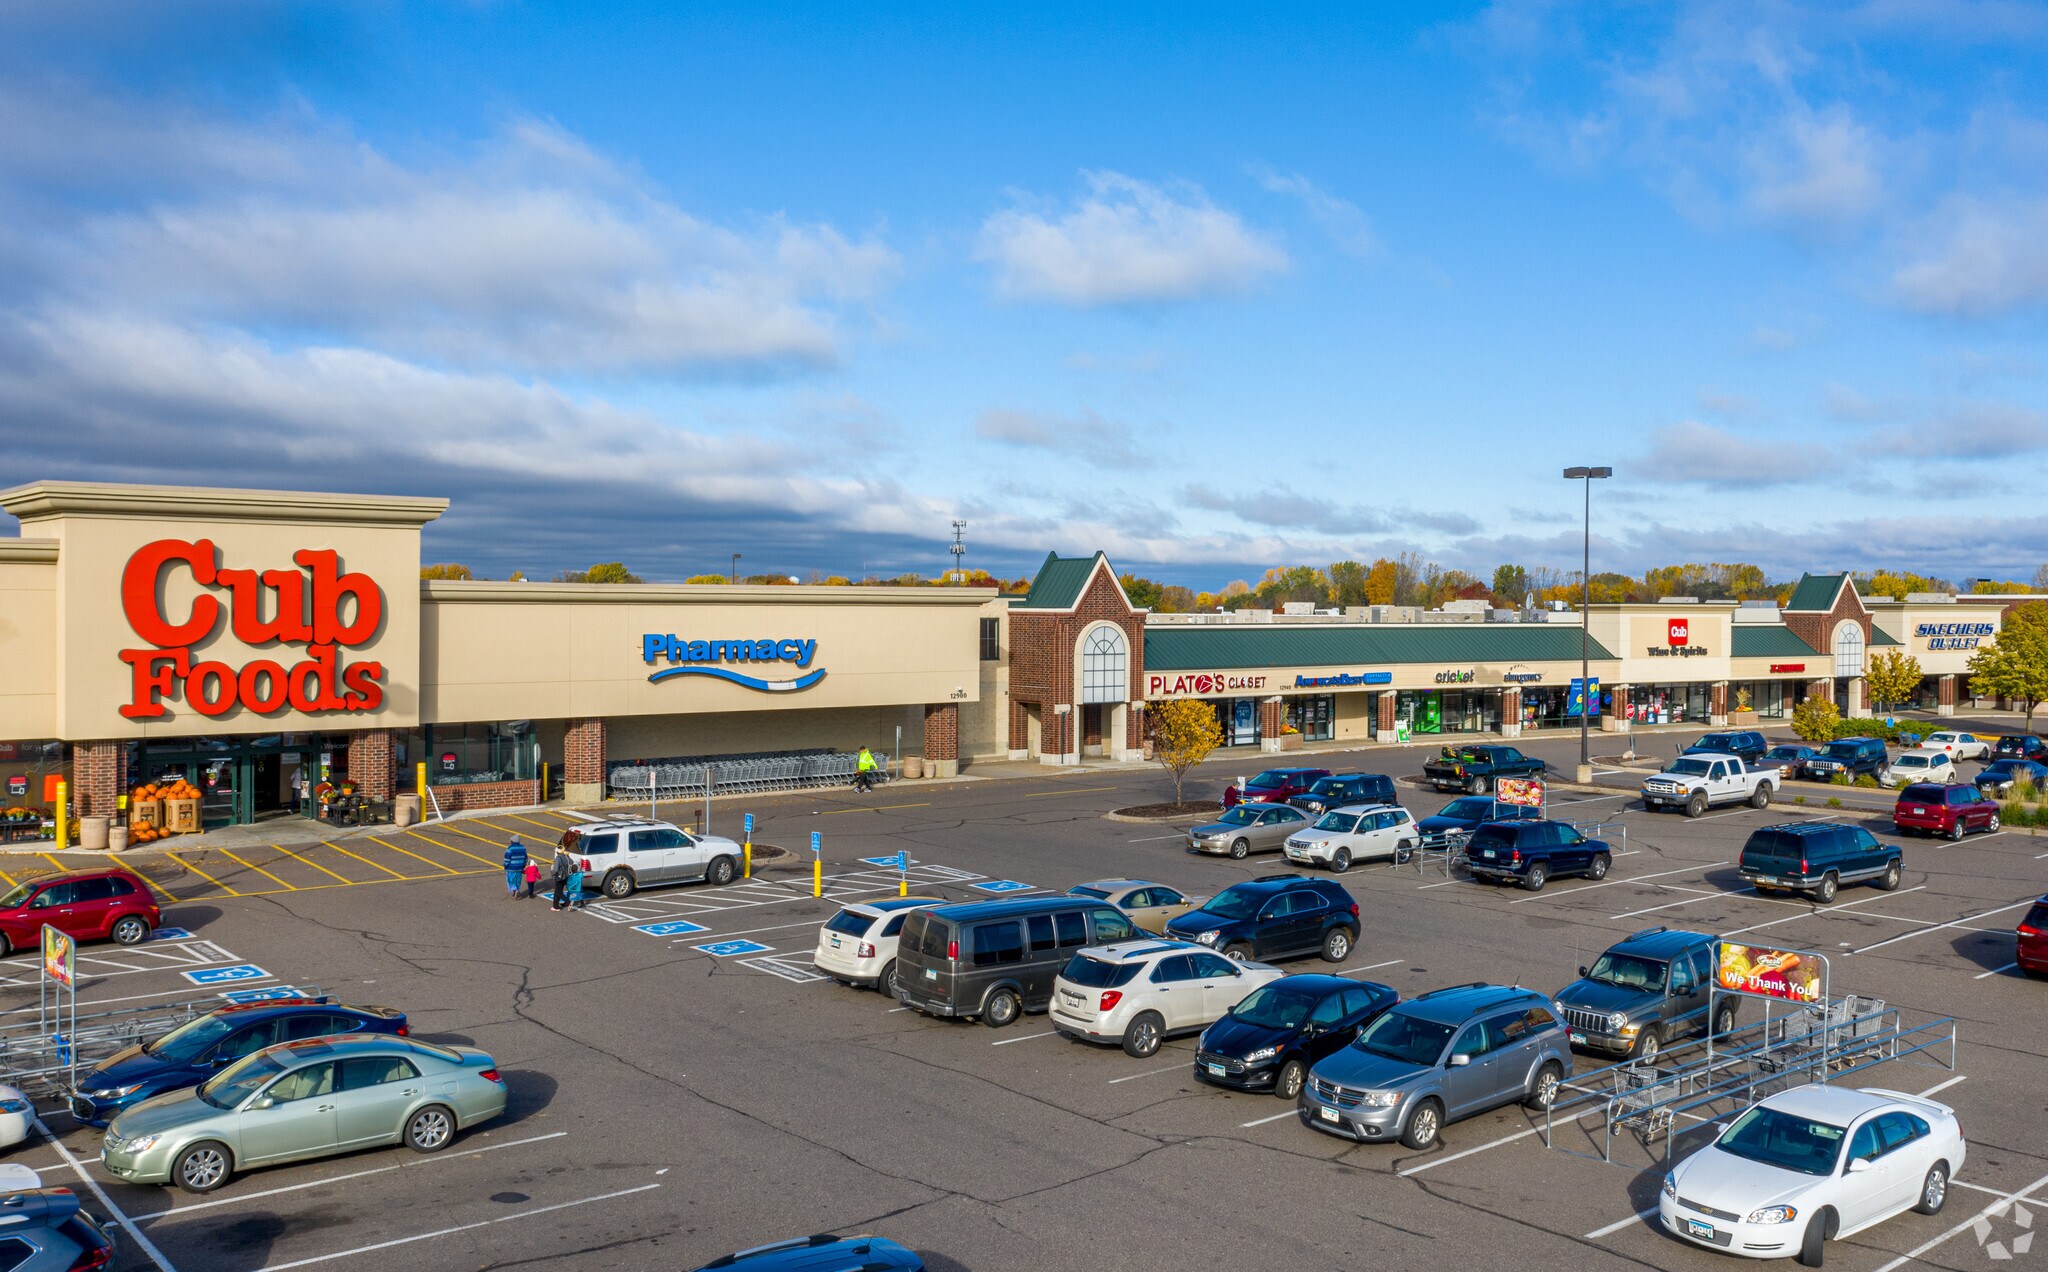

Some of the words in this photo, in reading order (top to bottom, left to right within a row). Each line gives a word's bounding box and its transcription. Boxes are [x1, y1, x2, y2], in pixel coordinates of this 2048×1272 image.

[120, 538, 382, 647] Cub
[1671, 626, 1687, 637] Cub
[1915, 623, 1994, 637] SKECHERS
[643, 633, 816, 667] Pharmacy
[1647, 647, 1669, 657] Wine
[1670, 645, 1679, 656] &
[1680, 646, 1708, 658] Spirits
[1928, 638, 1980, 650] OUTLET
[118, 644, 383, 717] Foods
[1150, 672, 1225, 695] PLATO'S
[1228, 676, 1266, 689] CLOSET
[1435, 669, 1475, 683] cricket
[1725, 971, 1745, 984] We
[1748, 975, 1786, 992] Thank
[1788, 982, 1812, 996] You
